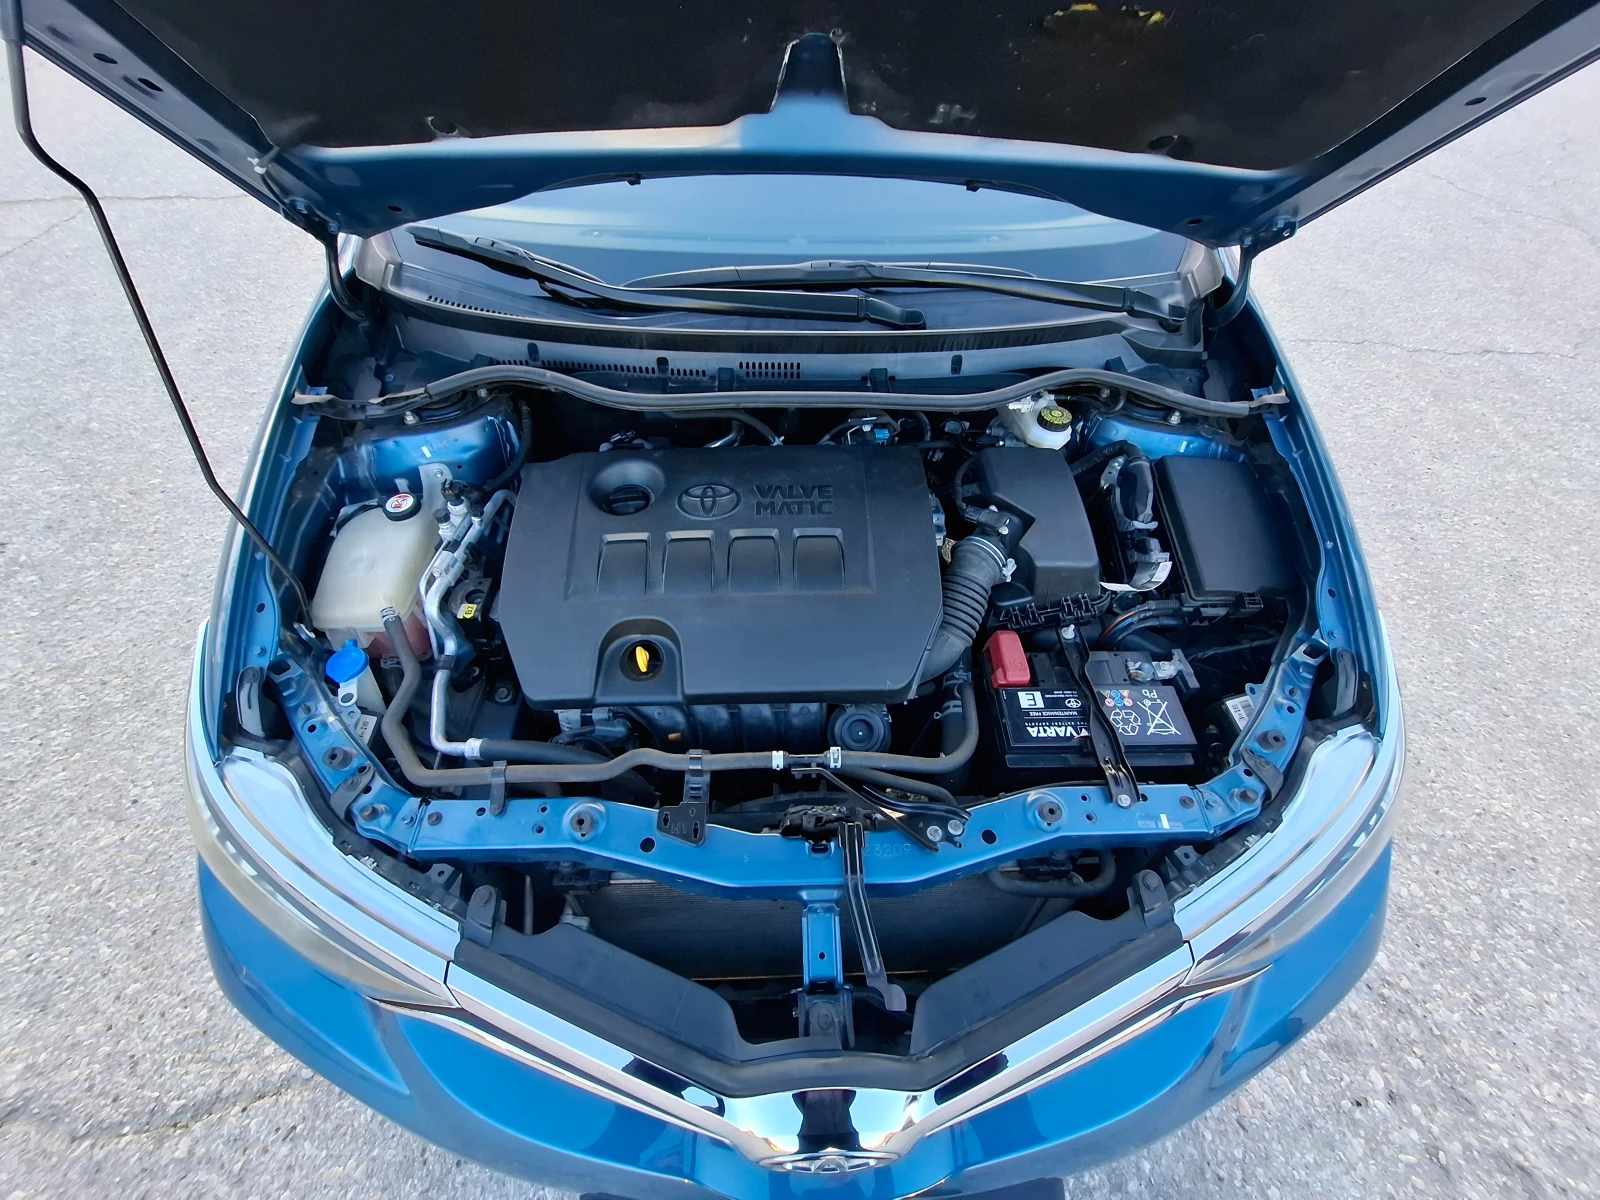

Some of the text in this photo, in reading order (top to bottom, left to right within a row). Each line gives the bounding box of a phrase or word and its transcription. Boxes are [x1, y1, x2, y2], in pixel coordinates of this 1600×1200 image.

[753, 484, 834, 500] VALVE
[754, 500, 834, 517] MATIC
[1024, 692, 1038, 707] E
[1141, 689, 1158, 699] Pb
[1026, 726, 1078, 738] VARTA
